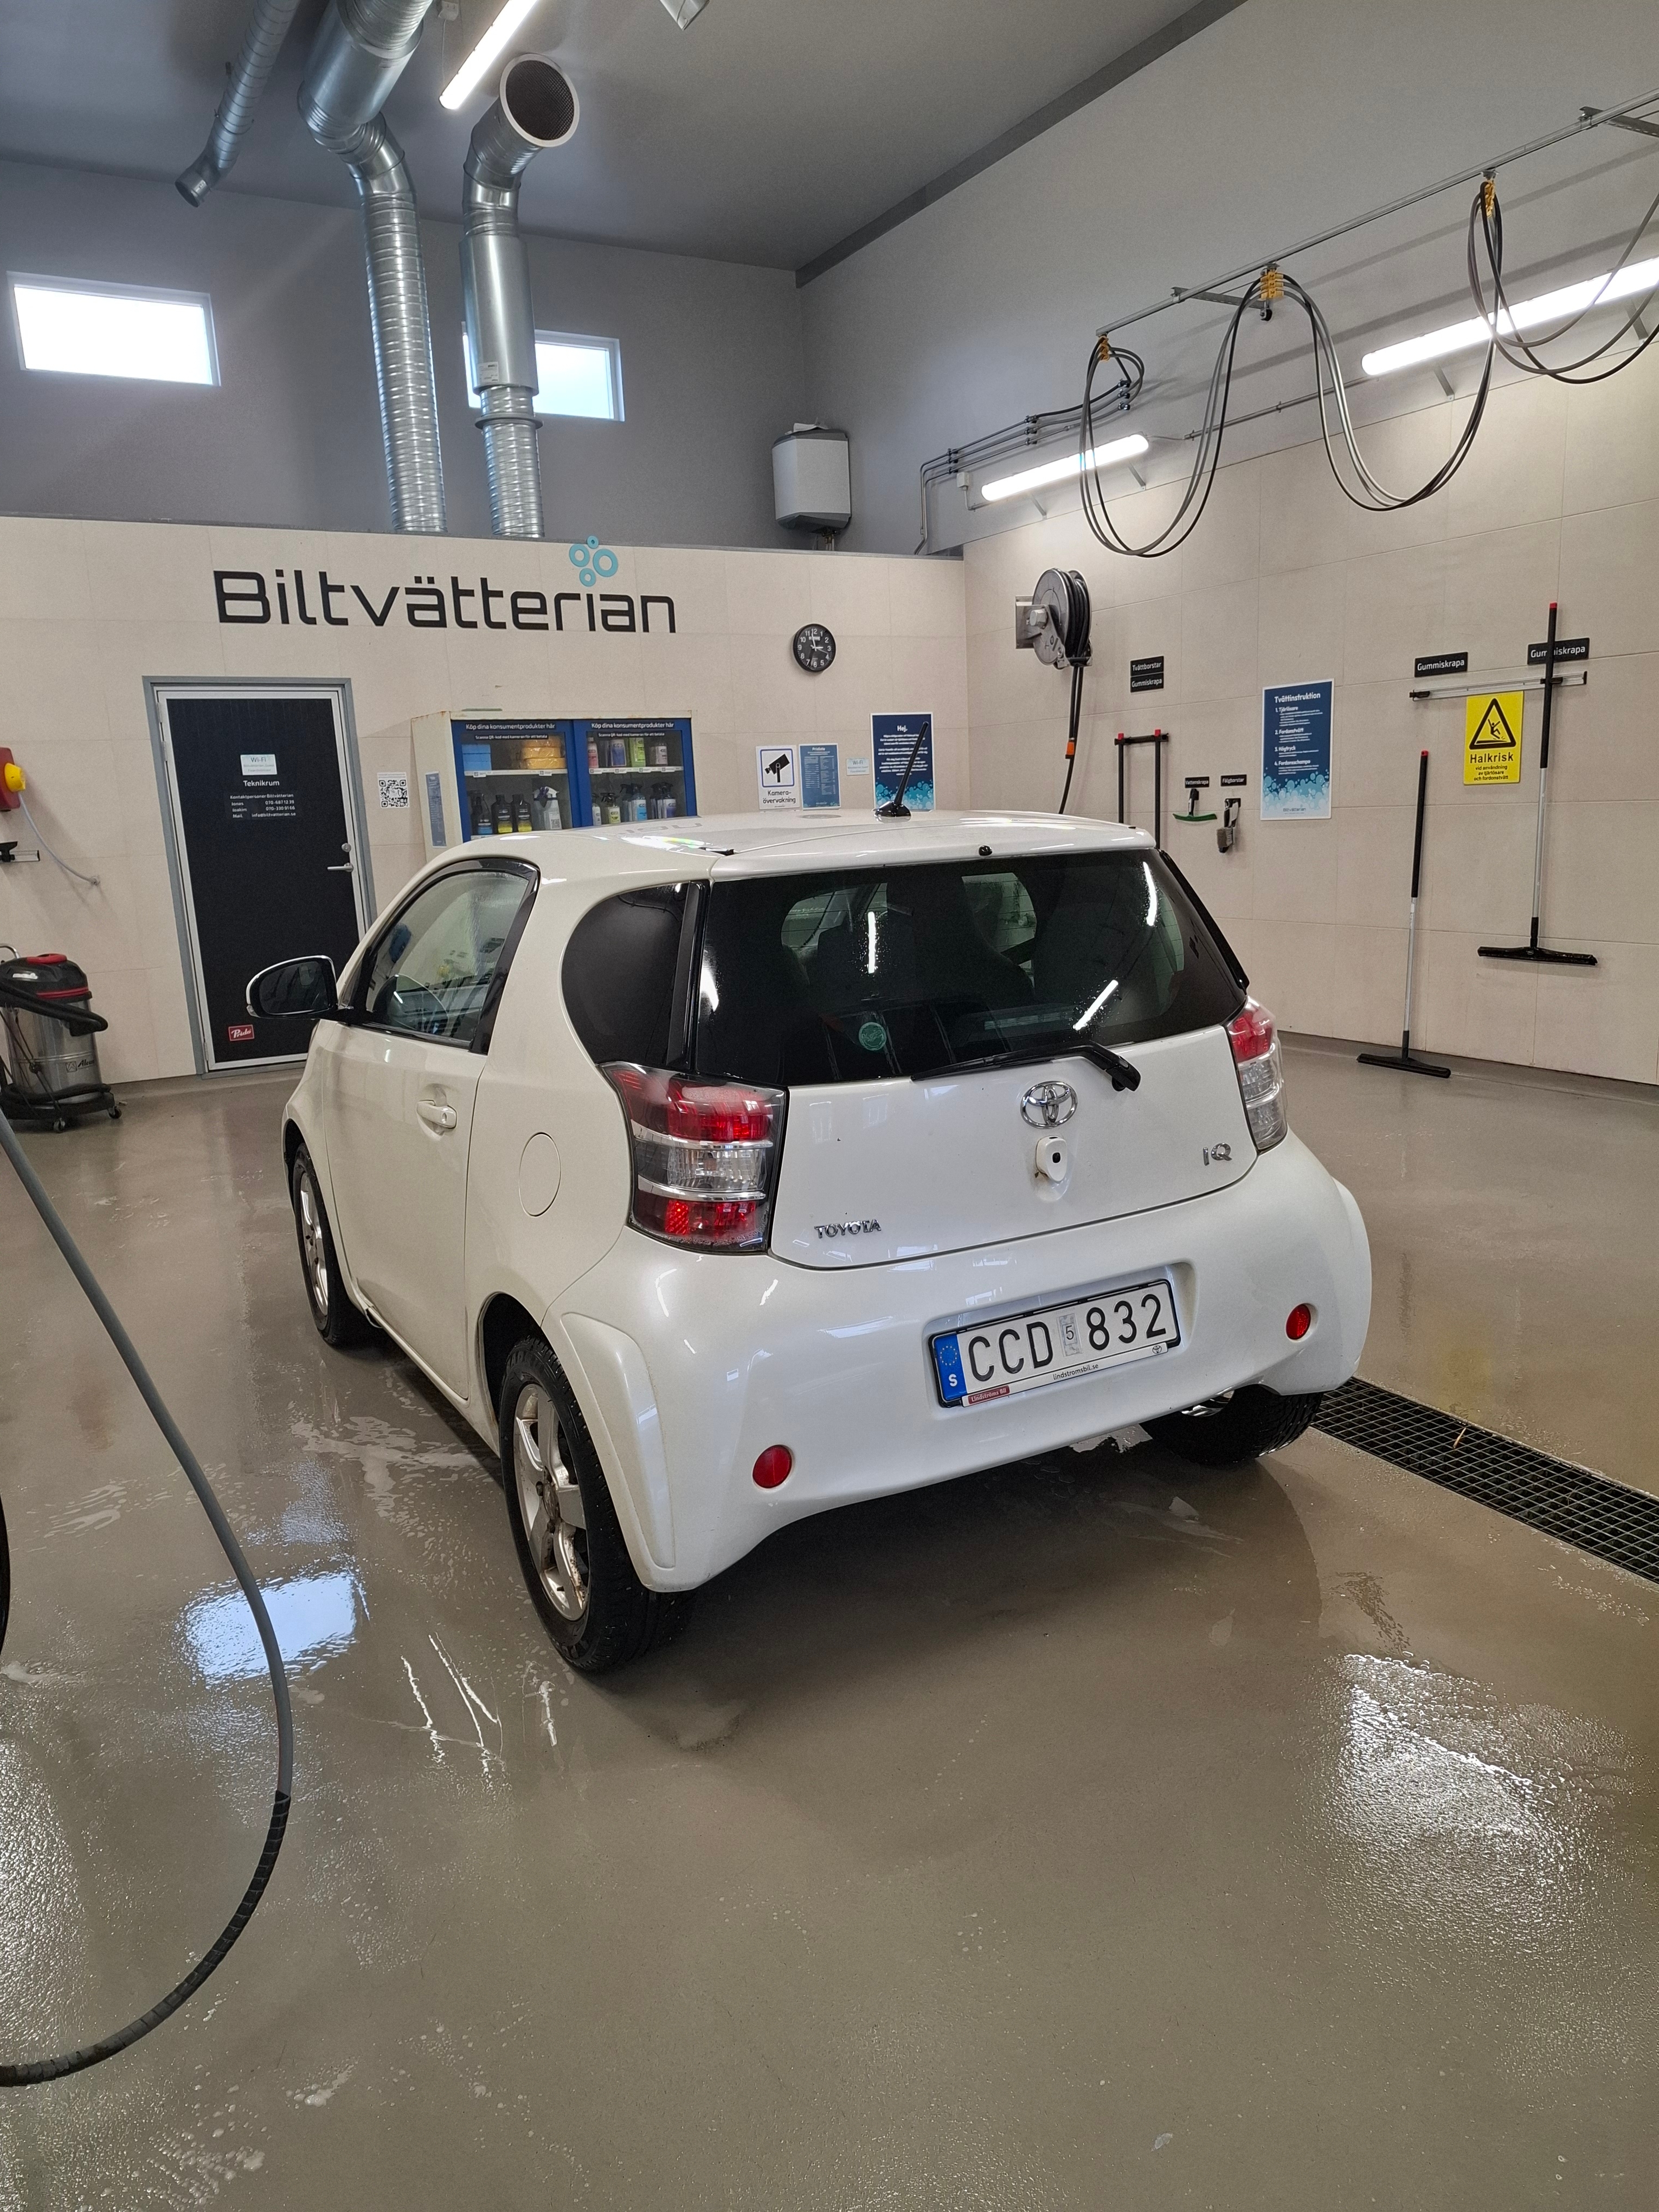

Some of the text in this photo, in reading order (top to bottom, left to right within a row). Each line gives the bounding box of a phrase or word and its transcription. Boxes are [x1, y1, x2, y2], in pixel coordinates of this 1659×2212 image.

[214, 569, 677, 633] Biltvätterian
[1132, 663, 1162, 672] Tvättborstar
[1417, 659, 1465, 671] Gummiskrapa
[1131, 679, 1162, 687] Gummiskrapa
[1274, 692, 1321, 703] Tvättinstruktion
[1470, 751, 1514, 763] Halkrisk
[814, 1218, 882, 1239] TOYOTA
[968, 1293, 1167, 1382] CCD 832
[1065, 1324, 1074, 1340] 5
[1053, 1364, 1099, 1380] lindstromsbil.se
[948, 1373, 958, 1387] S
[971, 1389, 999, 1403] Lindströms
